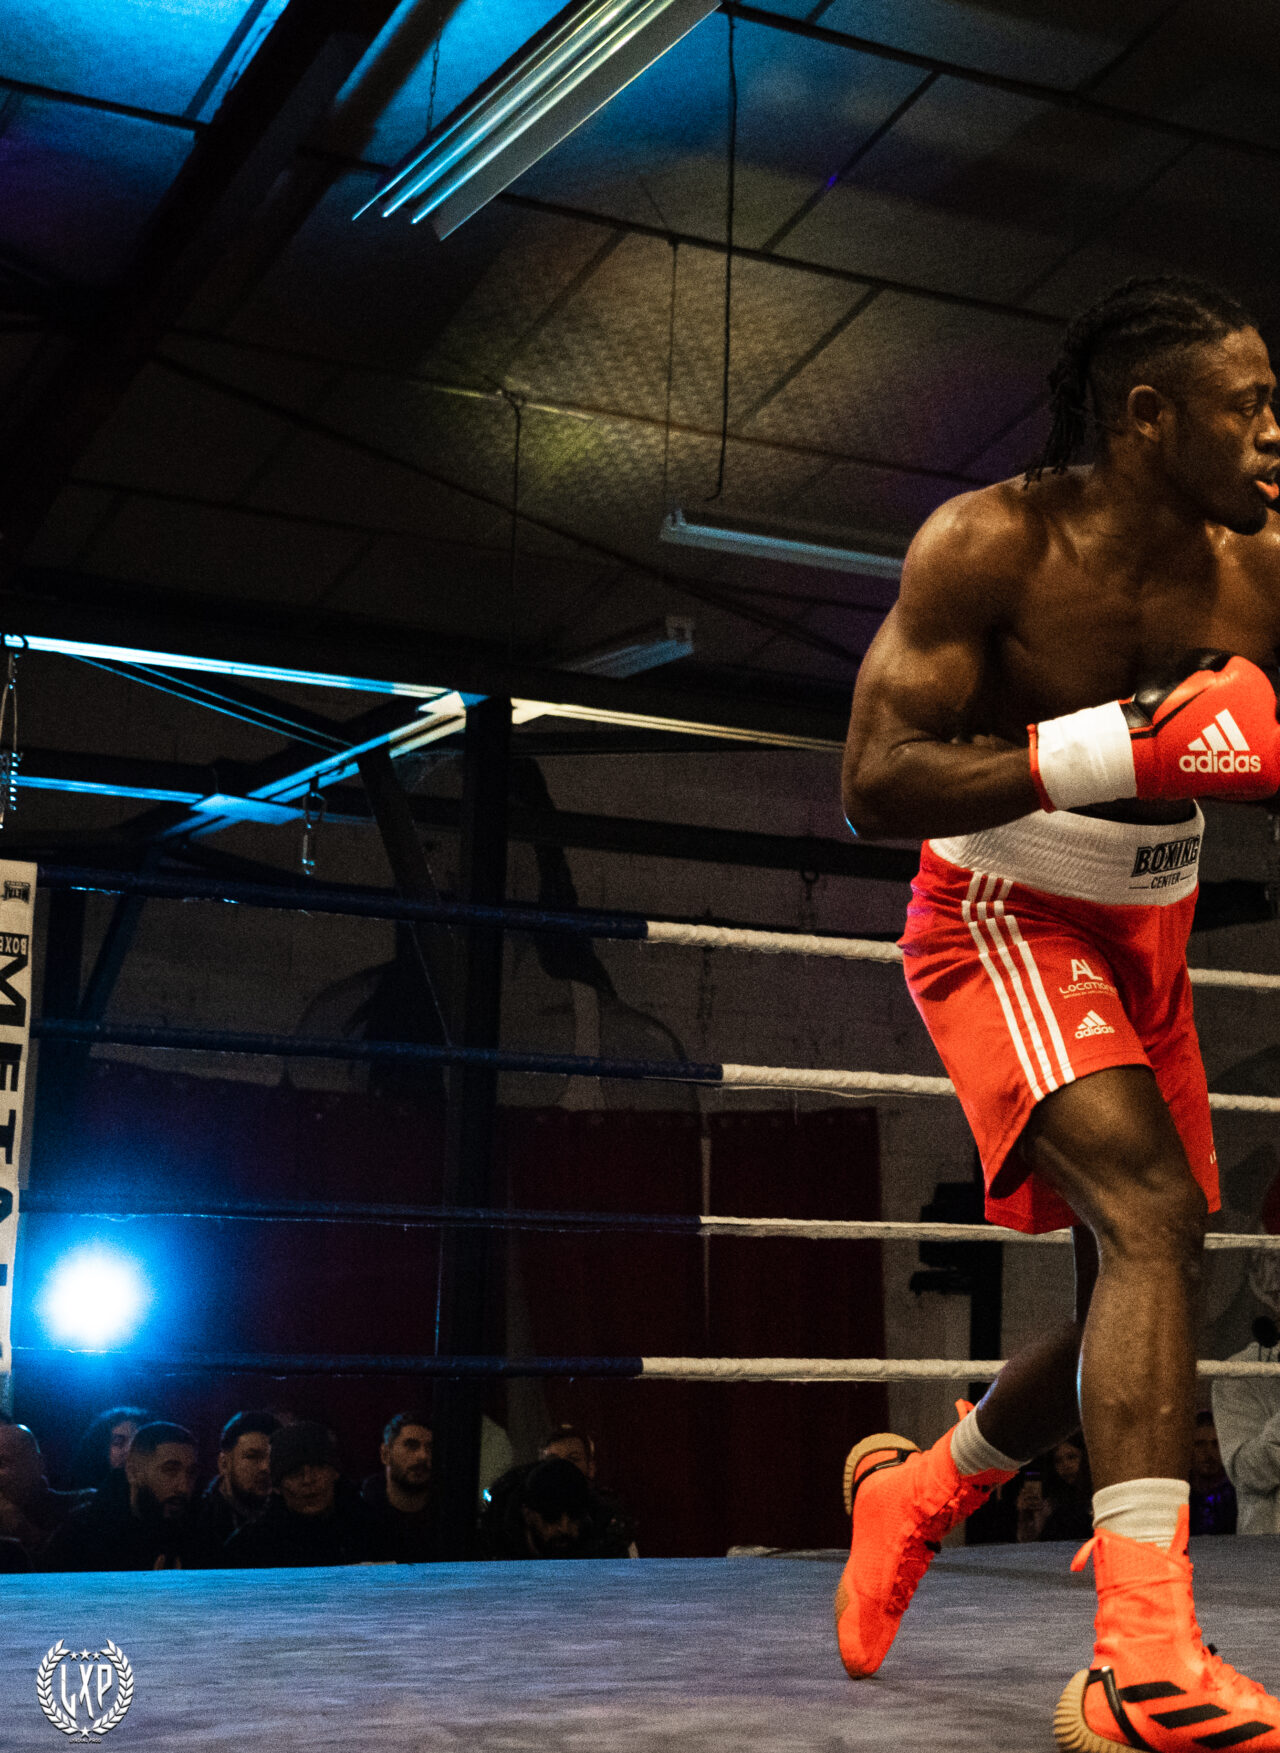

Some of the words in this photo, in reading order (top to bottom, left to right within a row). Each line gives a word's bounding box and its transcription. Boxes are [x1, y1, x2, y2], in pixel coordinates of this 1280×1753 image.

[1179, 750, 1261, 774] adidas
[1130, 834, 1200, 877] BOXING
[1151, 871, 1181, 889] CENTER
[1075, 1025, 1116, 1039] adidas
